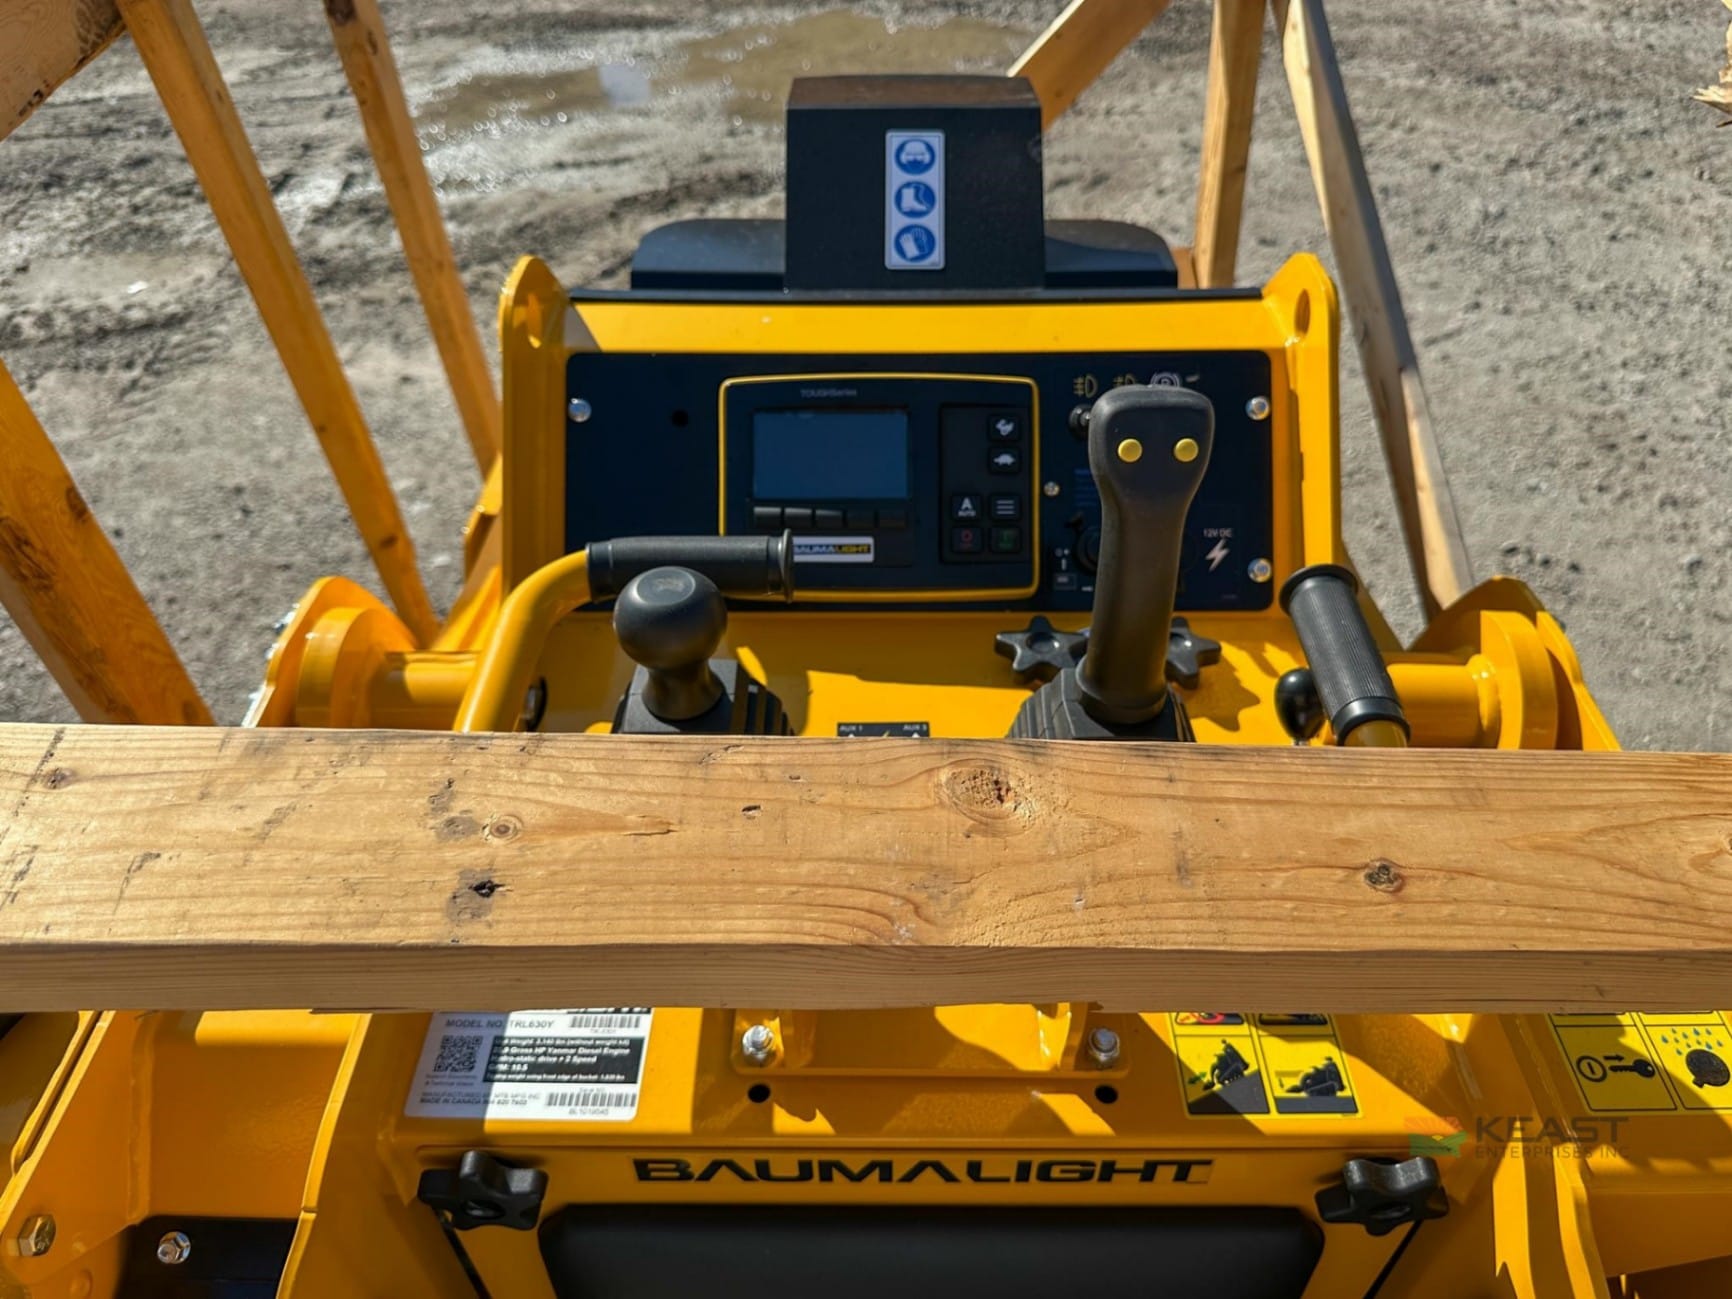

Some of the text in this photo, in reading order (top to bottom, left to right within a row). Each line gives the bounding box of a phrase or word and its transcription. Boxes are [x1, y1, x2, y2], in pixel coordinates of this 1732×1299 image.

[961, 497, 973, 510] A
[445, 1019, 483, 1028] MODEL
[509, 1019, 556, 1029] TRL630Y
[510, 1046, 533, 1055] Gross
[534, 1047, 546, 1055] HP
[547, 1047, 576, 1055] Yanmar
[577, 1047, 602, 1056] Diesel
[603, 1047, 630, 1058] Engine
[571, 1055, 597, 1065] Speed
[451, 1097, 481, 1105] CANADA
[633, 1157, 1214, 1184] BAUMALIGHT
